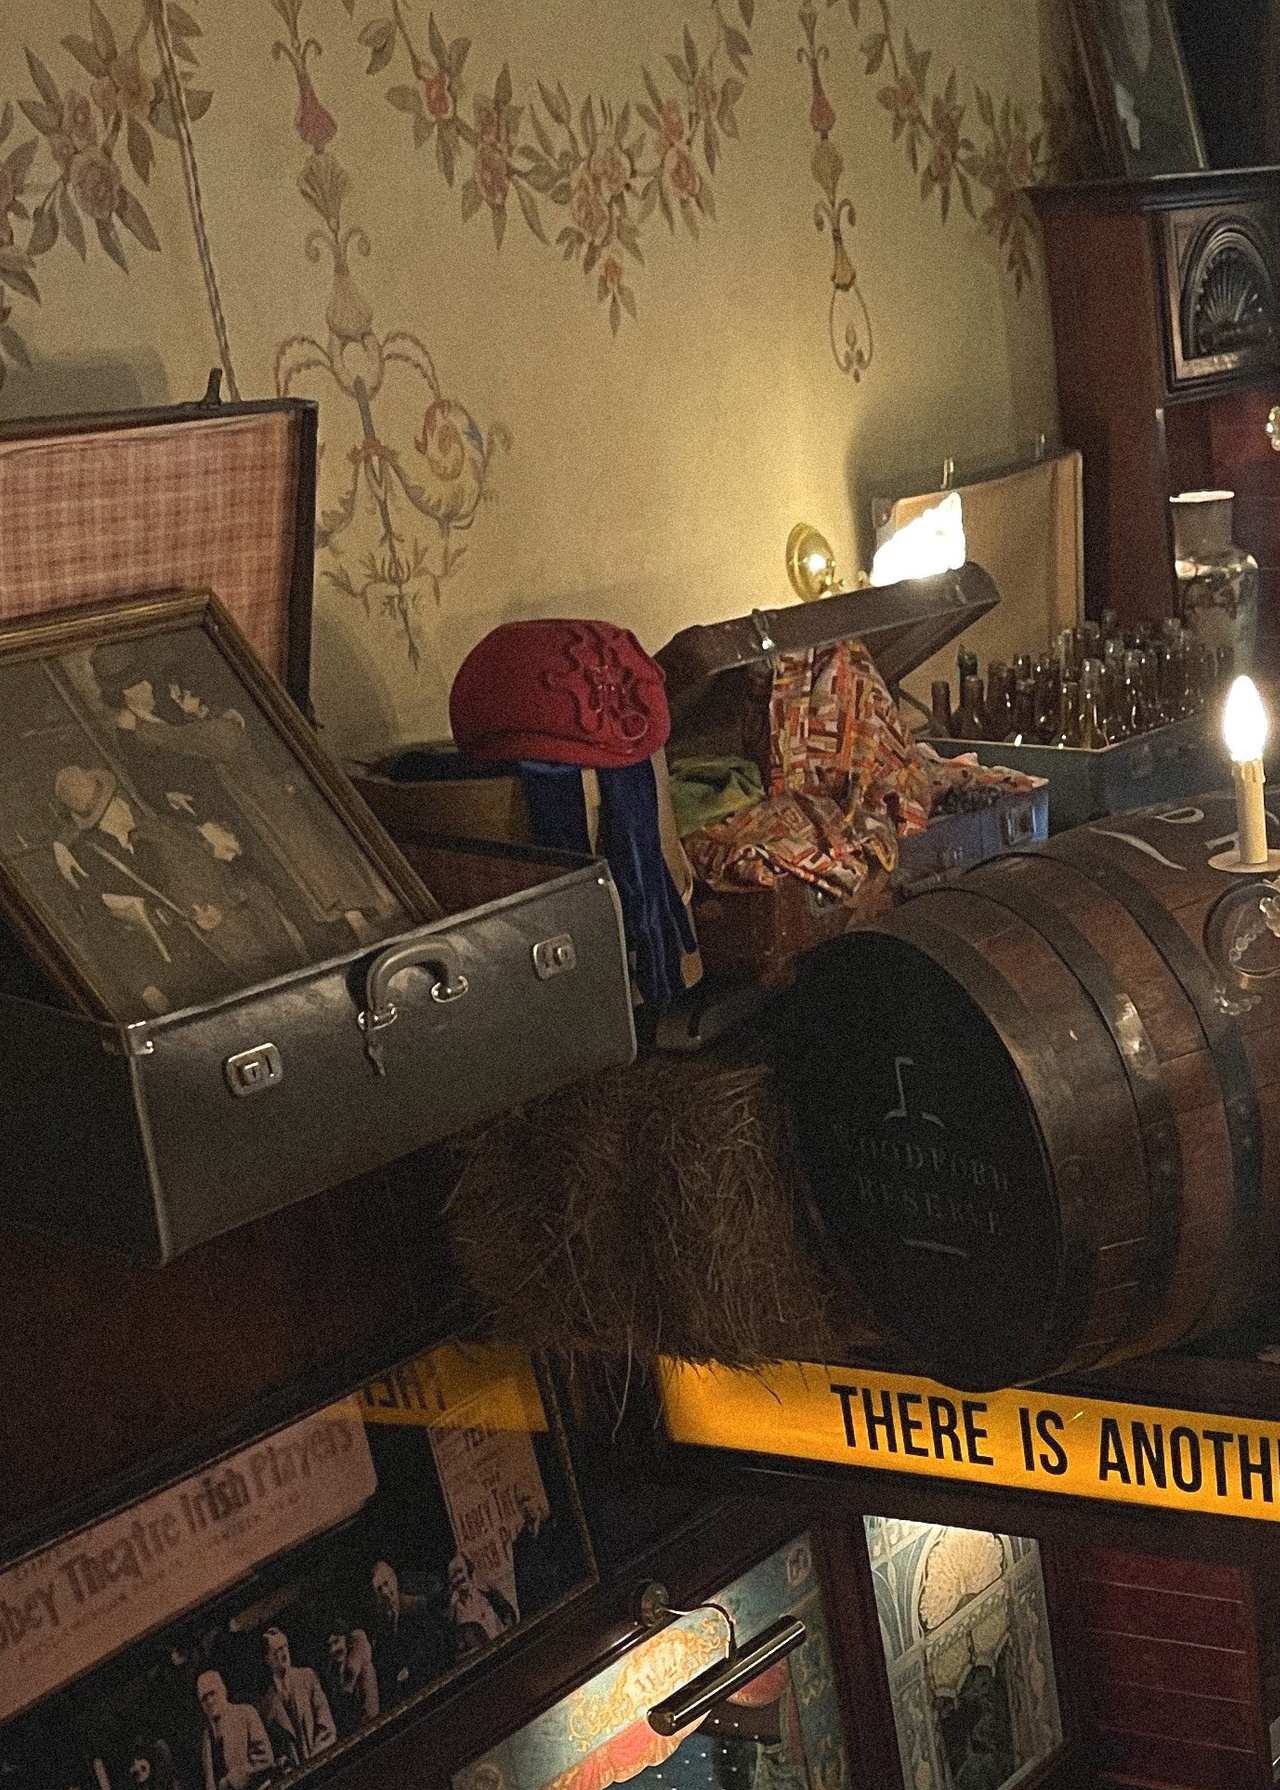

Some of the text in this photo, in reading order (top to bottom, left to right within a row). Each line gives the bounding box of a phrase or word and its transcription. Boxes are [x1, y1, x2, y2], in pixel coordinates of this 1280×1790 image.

[830, 1384, 993, 1466] THERE
[1020, 1408, 1068, 1476] IS
[58, 1510, 181, 1604] Theatre
[179, 1468, 251, 1534] Irish
[249, 1421, 353, 1498] Players
